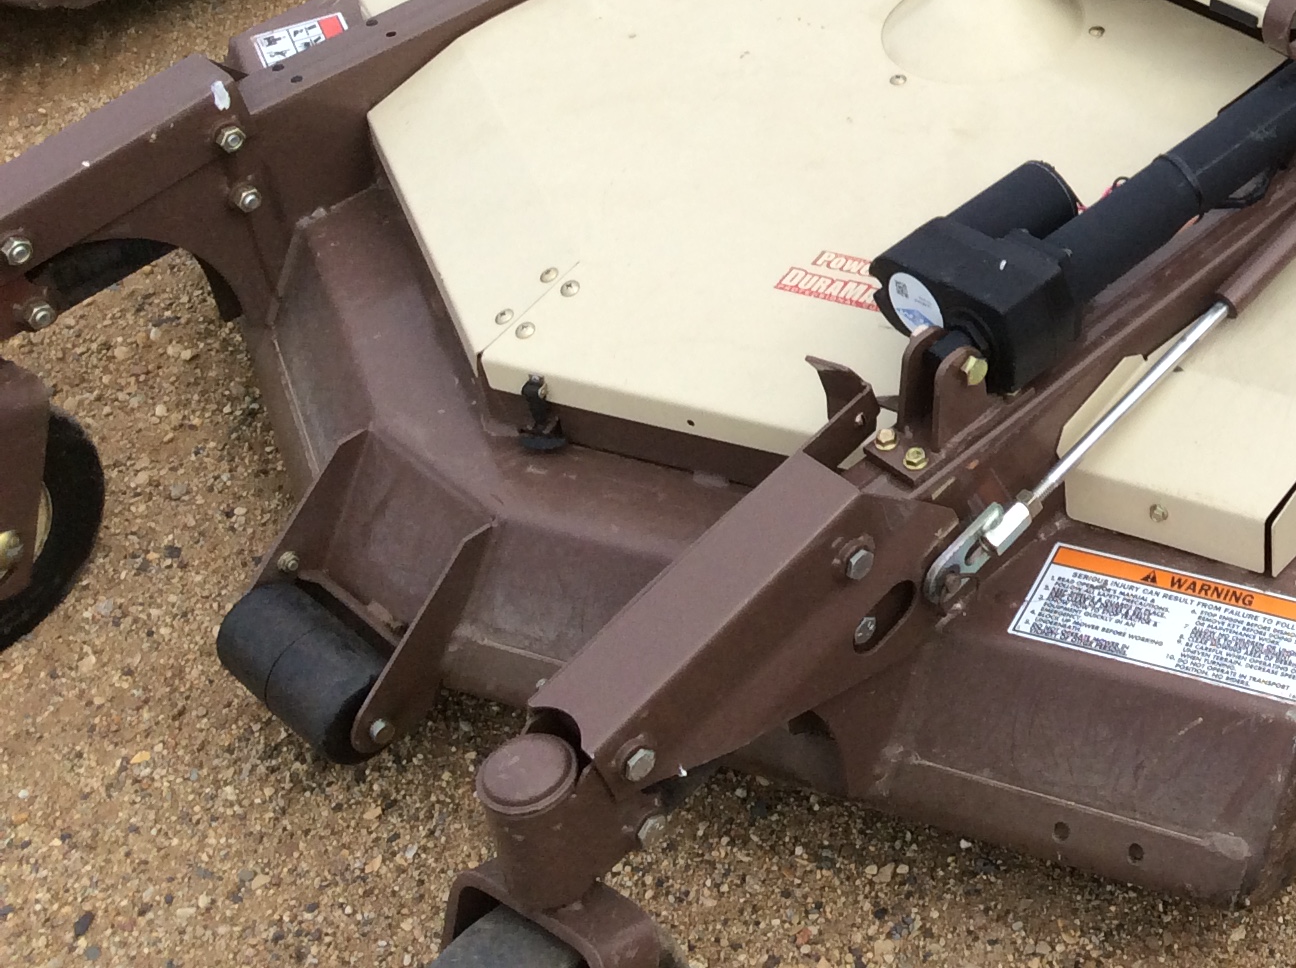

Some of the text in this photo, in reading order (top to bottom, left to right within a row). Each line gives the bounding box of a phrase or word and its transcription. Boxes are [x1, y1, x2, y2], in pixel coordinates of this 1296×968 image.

[780, 268, 878, 303] DURAMA
[1071, 571, 1109, 585] SERIOUS
[1109, 580, 1140, 592] INJURY
[1141, 588, 1160, 597] CAN
[1161, 592, 1194, 605] RESULT
[1195, 601, 1221, 611] FROM
[1223, 607, 1259, 621] FAILURE
[1167, 575, 1256, 607] WARNING
